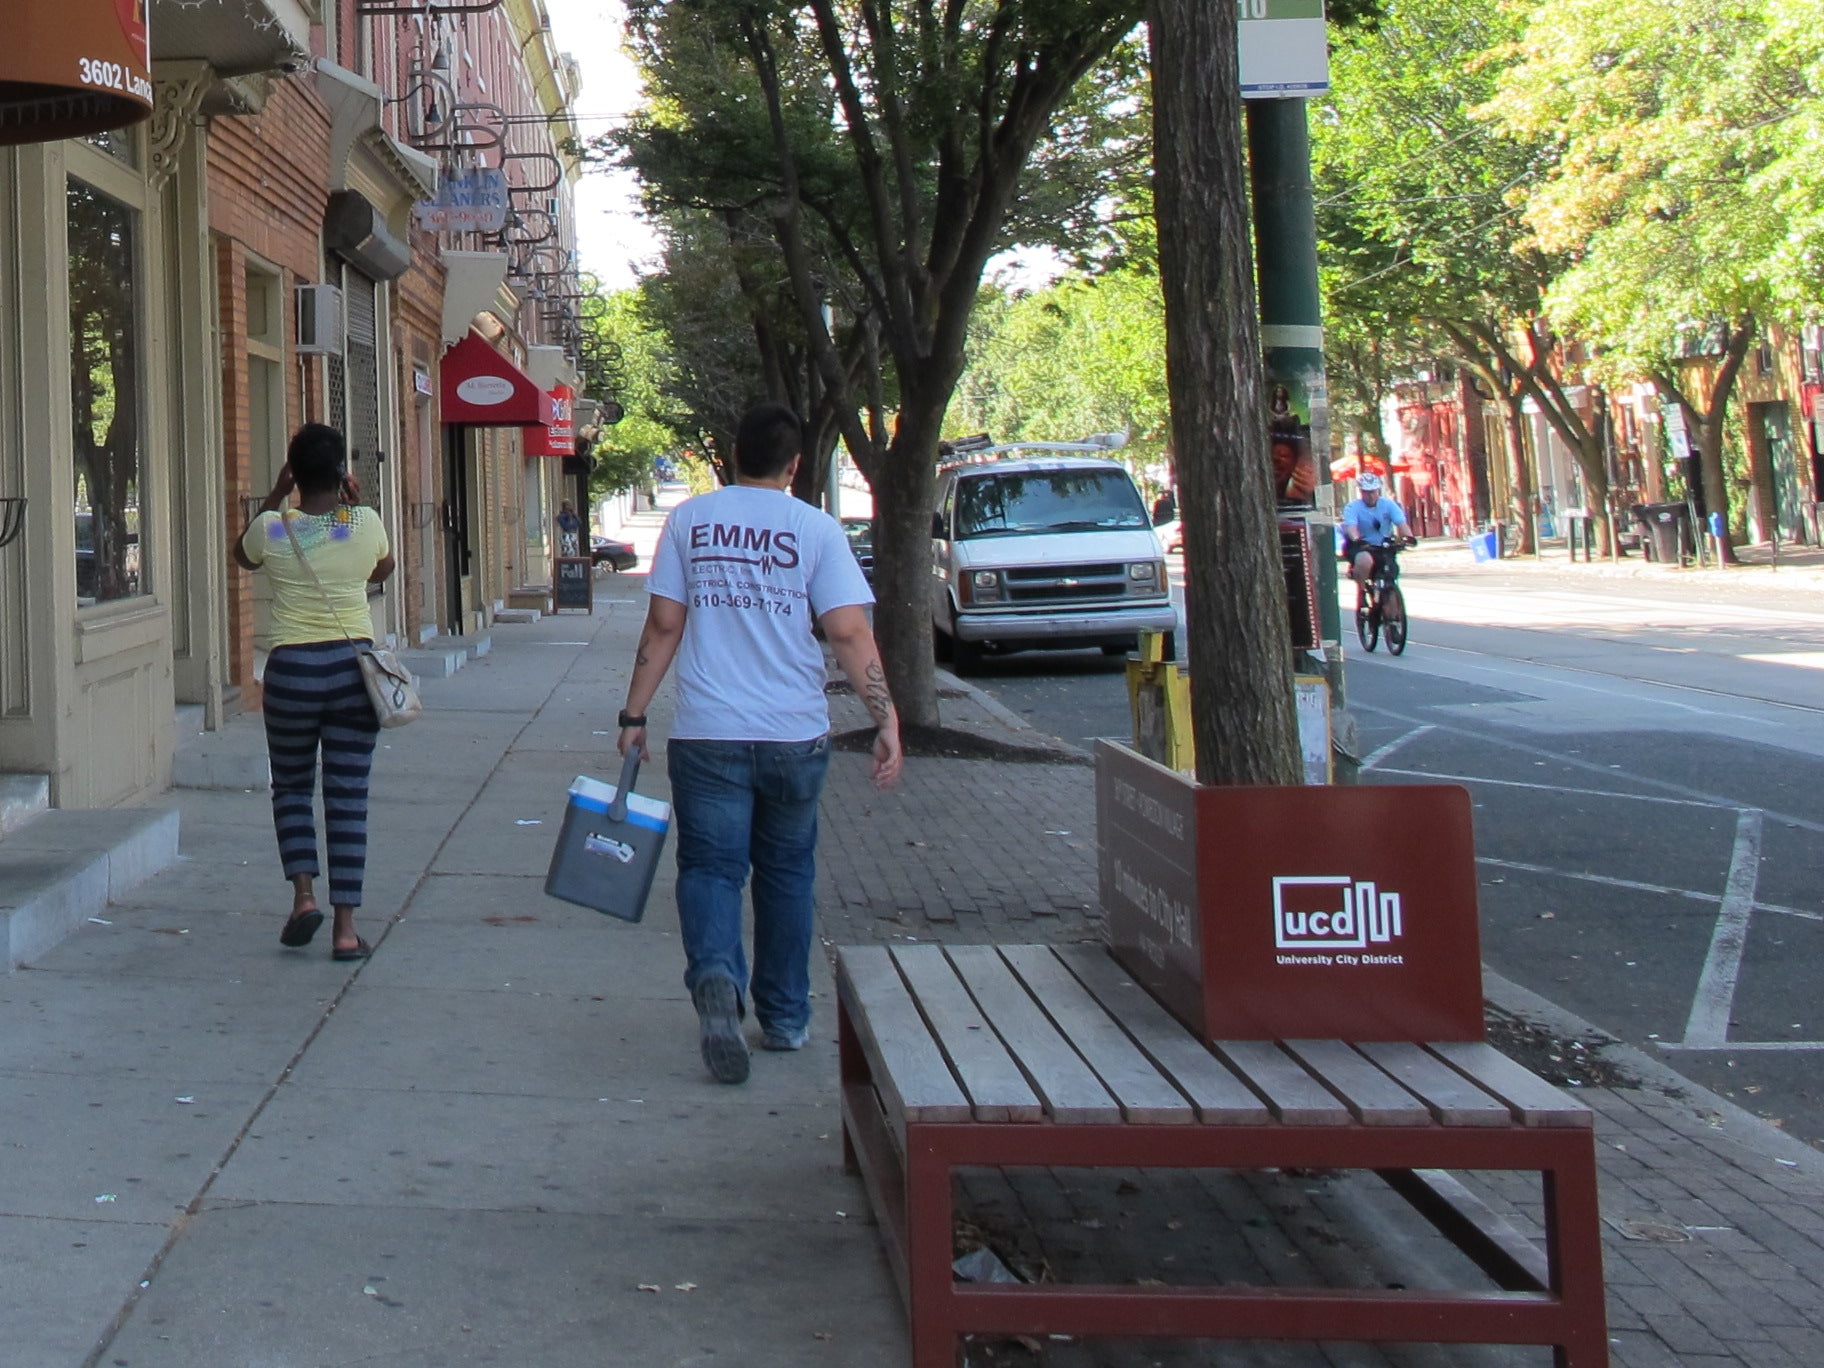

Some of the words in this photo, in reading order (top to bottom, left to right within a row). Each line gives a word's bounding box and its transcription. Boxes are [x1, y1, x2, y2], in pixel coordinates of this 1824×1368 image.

[79, 57, 124, 91] 3602
[691, 523, 799, 569] EMMS
[693, 594, 793, 617] 610-369-7174
[1285, 887, 1354, 936] ucd
[1276, 954, 1333, 966] University
[1336, 954, 1358, 966] City
[1362, 954, 1404, 965] District
